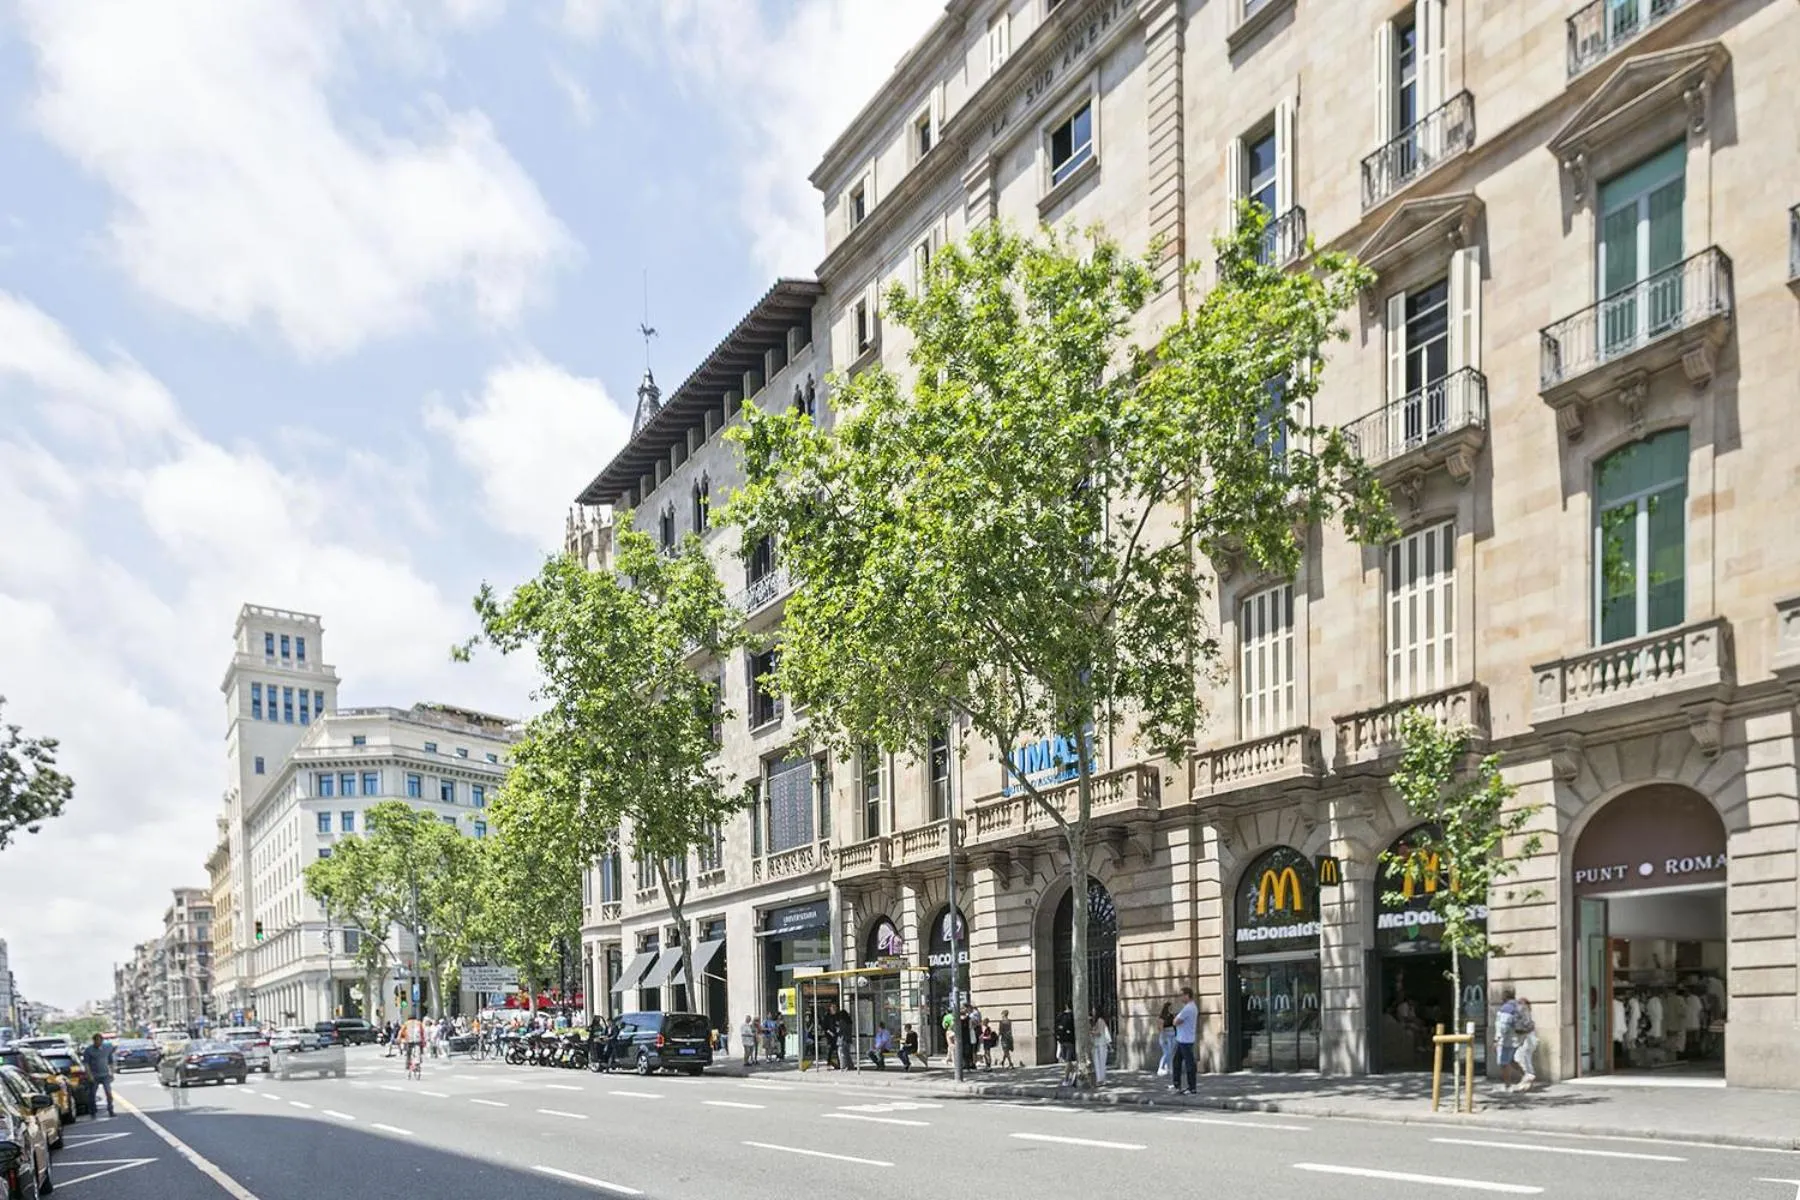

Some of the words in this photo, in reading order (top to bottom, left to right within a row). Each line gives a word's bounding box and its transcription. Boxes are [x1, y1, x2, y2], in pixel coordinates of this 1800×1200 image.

[991, 113, 1009, 138] LA
[1026, 69, 1053, 105] SUD
[1575, 864, 1628, 883] PUNT
[1665, 853, 1728, 874] ROMA
[1236, 921, 1322, 942] McDonald's
[927, 953, 951, 967] TACO
